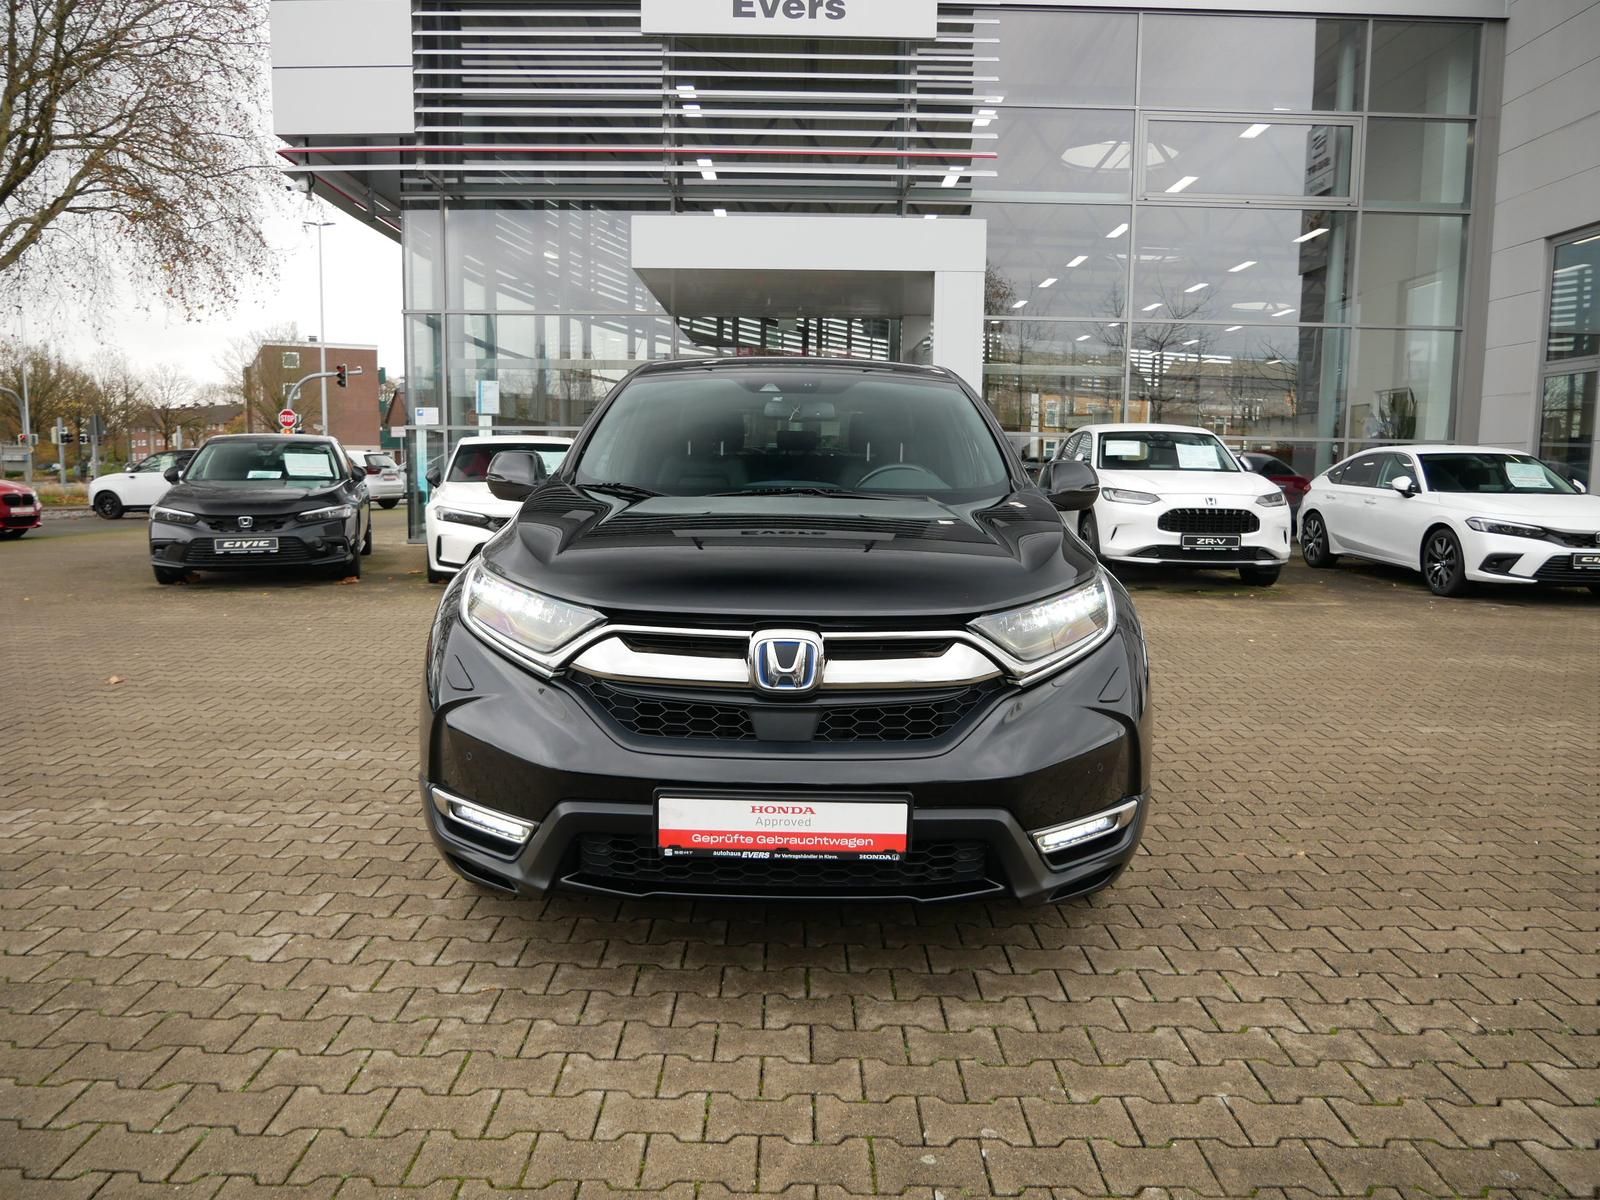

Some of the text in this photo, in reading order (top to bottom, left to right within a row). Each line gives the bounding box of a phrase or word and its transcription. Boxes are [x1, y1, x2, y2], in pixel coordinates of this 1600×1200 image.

[732, 0, 846, 20] Evers
[280, 414, 296, 422] STOP
[223, 540, 270, 549] CIVIC
[751, 805, 816, 815] HONDA
[755, 817, 812, 828] Approved
[691, 833, 874, 848] Geprüfte Gebrauchtwagen
[741, 851, 770, 859] EVERS
